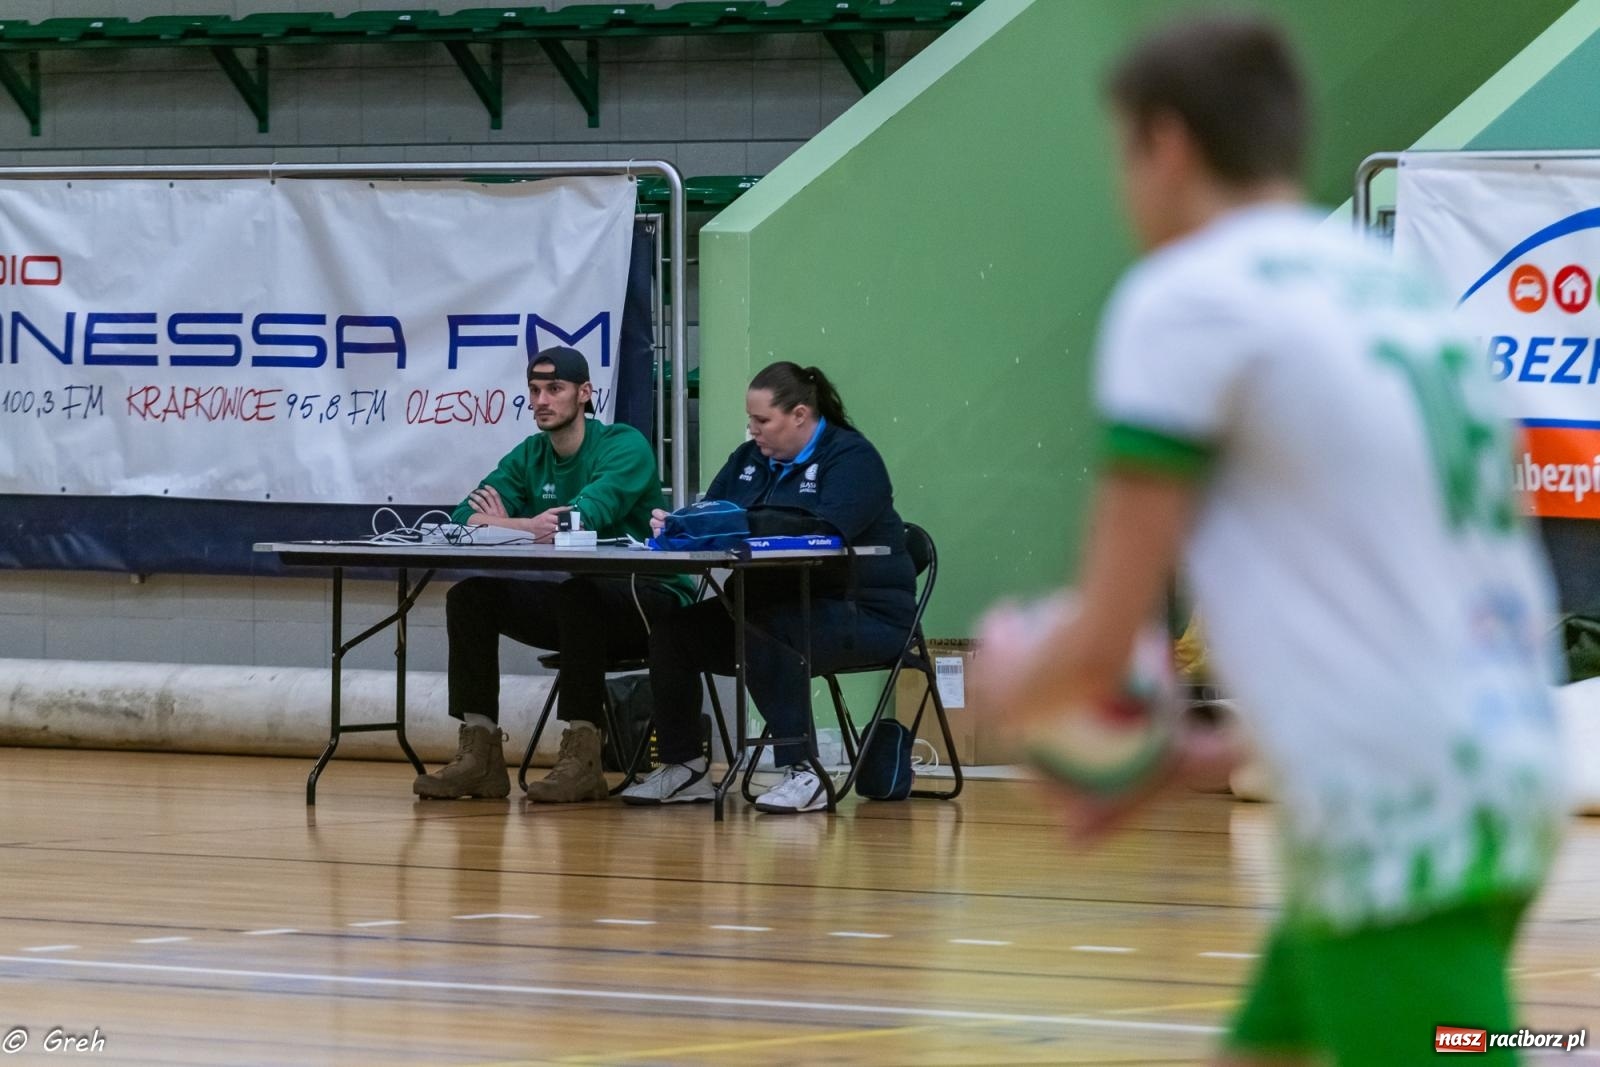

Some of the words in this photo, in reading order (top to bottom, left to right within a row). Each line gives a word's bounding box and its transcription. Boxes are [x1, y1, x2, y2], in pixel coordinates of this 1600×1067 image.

[0, 255, 62, 286] IO
[0, 311, 406, 369] NESSA
[447, 311, 611, 369] FM
[2, 389, 56, 418] 100,3
[62, 384, 104, 420] FM
[126, 386, 283, 423] KRAPKOWICE
[286, 393, 342, 424] 95,8
[347, 389, 388, 425] FM
[406, 389, 506, 426] OLESNO
